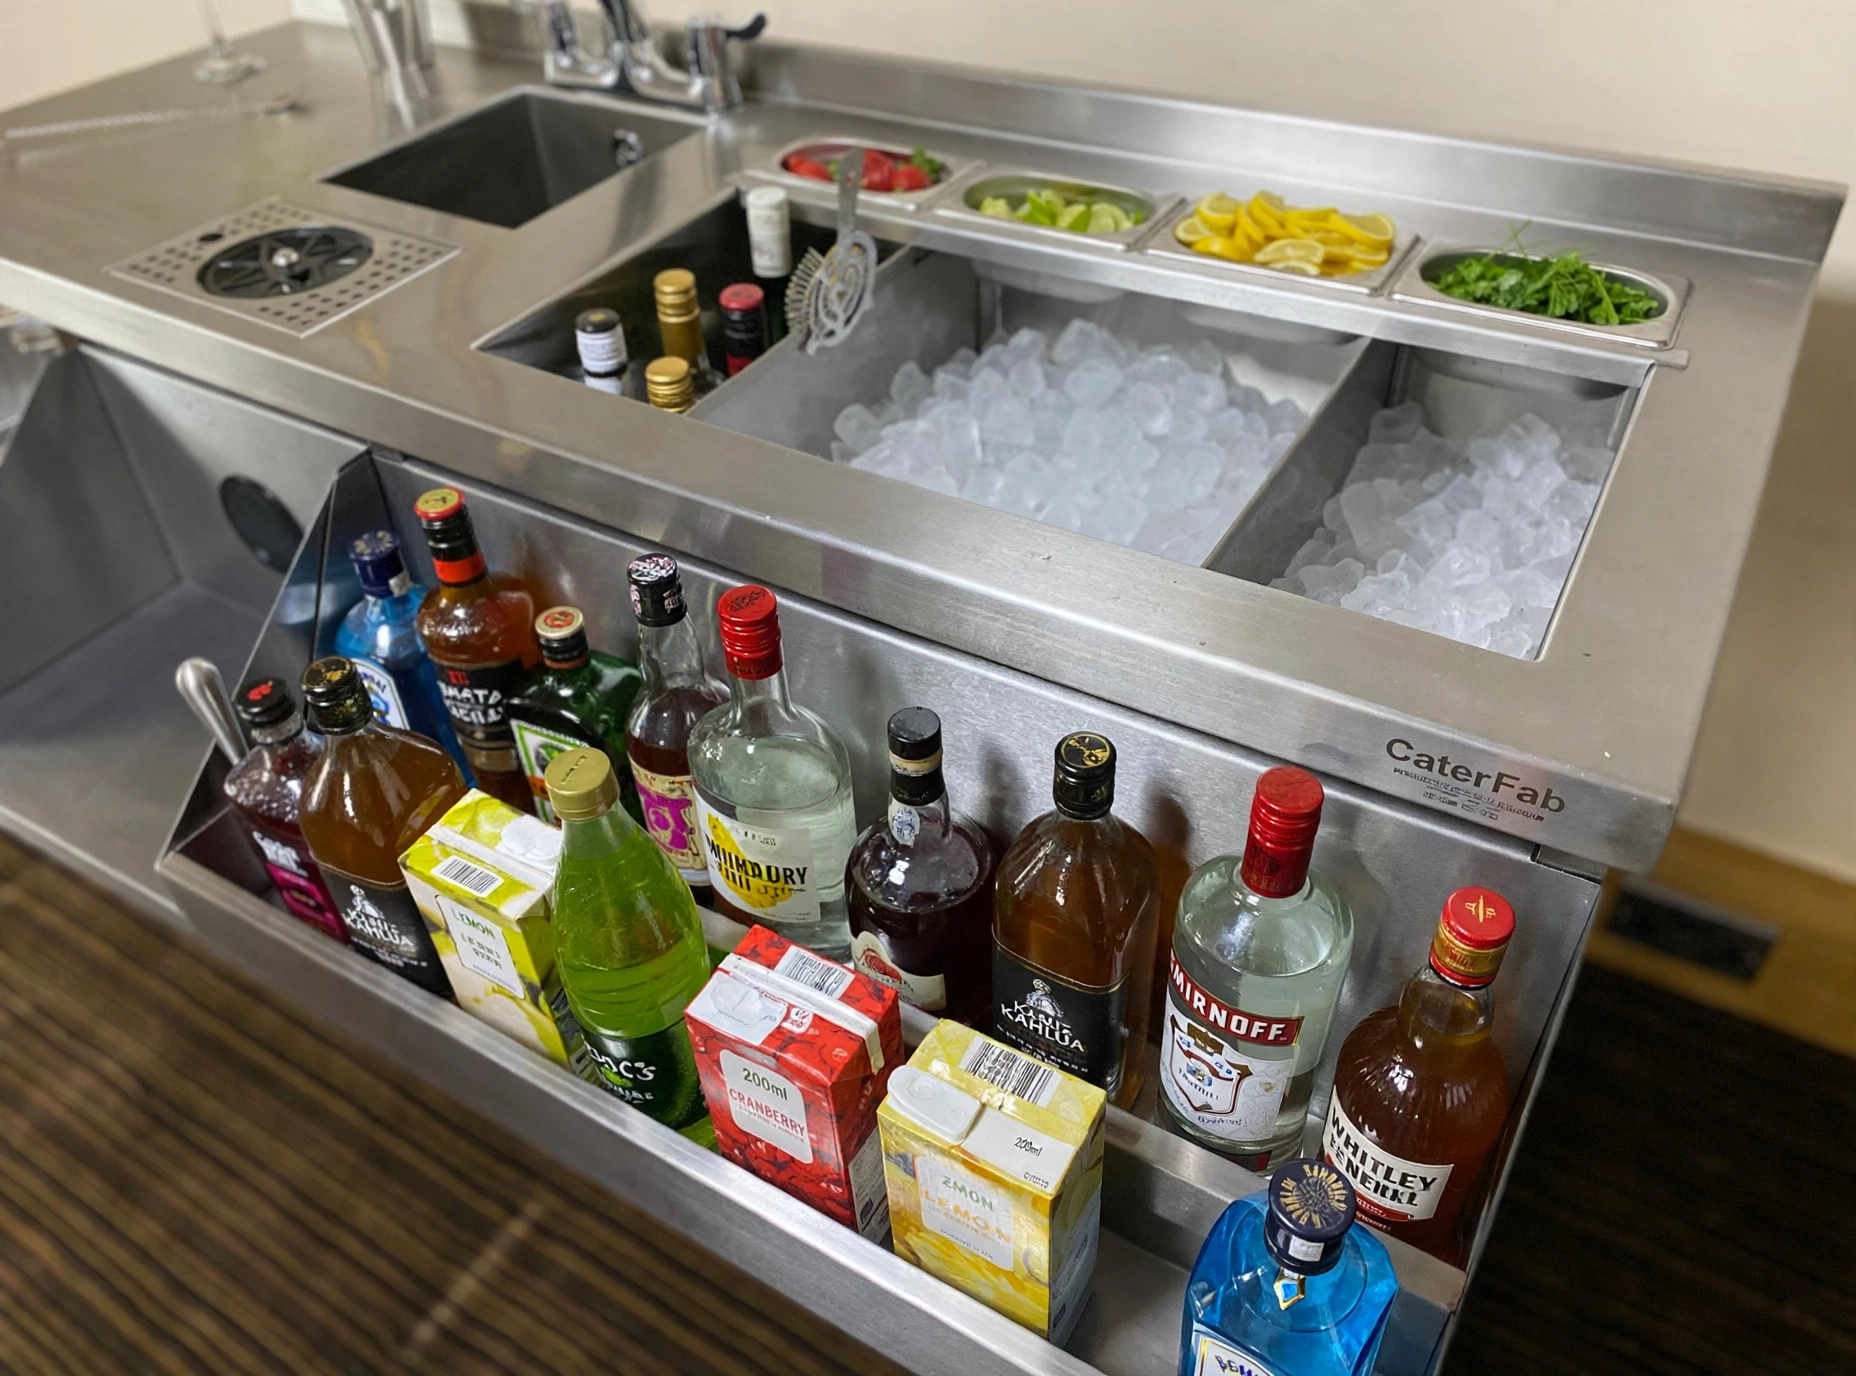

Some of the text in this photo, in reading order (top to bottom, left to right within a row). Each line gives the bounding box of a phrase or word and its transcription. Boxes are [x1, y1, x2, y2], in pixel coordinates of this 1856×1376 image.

[1386, 738, 1566, 813] CaterFab
[728, 1088, 805, 1137] CRANBERRY
[742, 1067, 788, 1101] 200ml
[1331, 1106, 1438, 1192] WHITLEY
